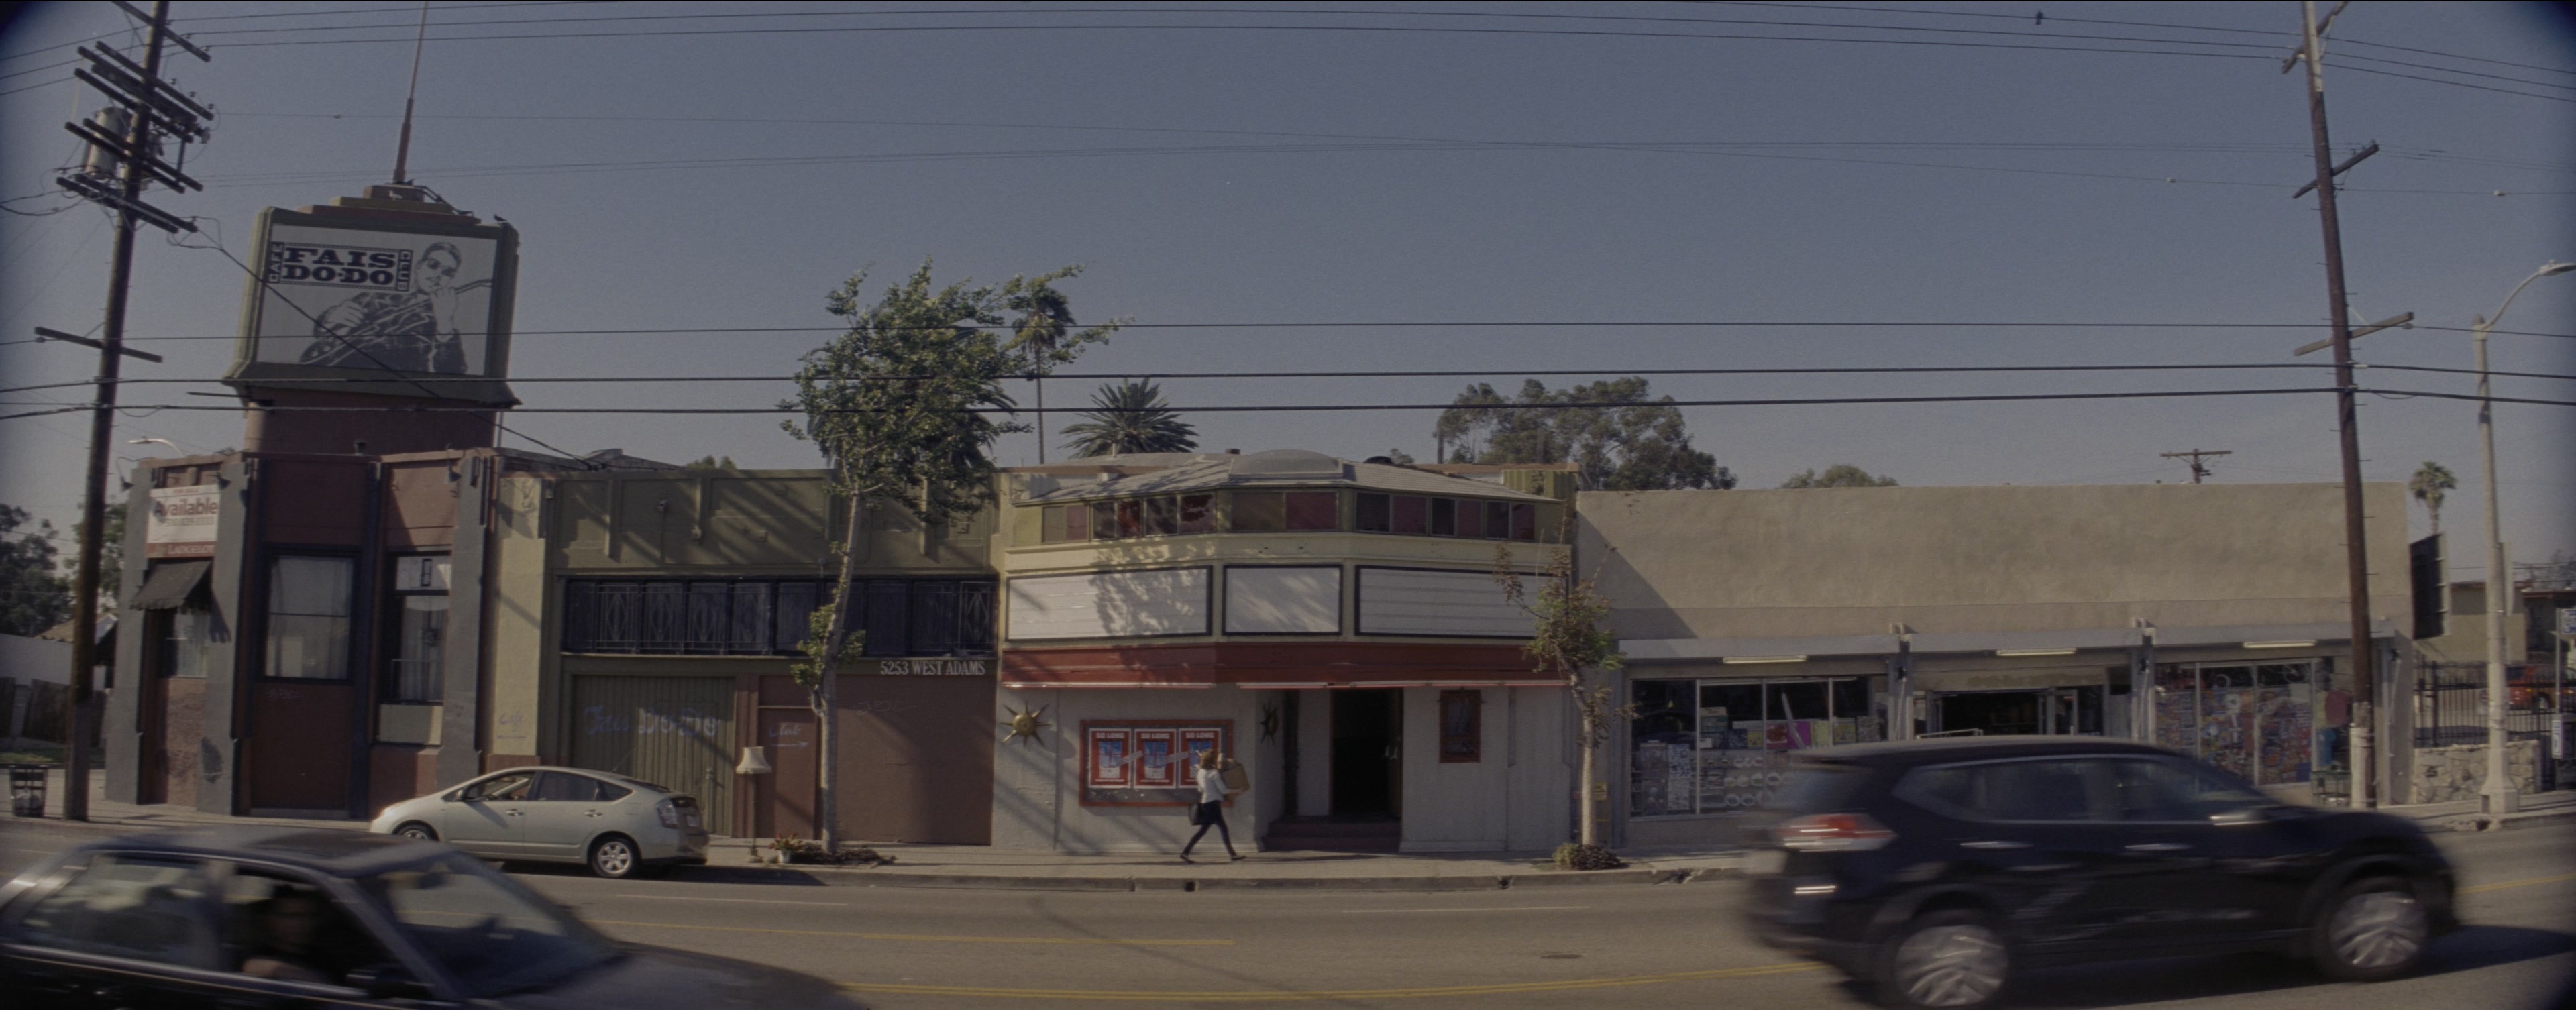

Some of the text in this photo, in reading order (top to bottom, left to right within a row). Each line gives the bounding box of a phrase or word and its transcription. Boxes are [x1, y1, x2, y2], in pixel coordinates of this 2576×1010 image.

[284, 247, 395, 268] FAIS
[154, 497, 217, 517] Available
[880, 661, 985, 675] 5253 WEST ADAMS
